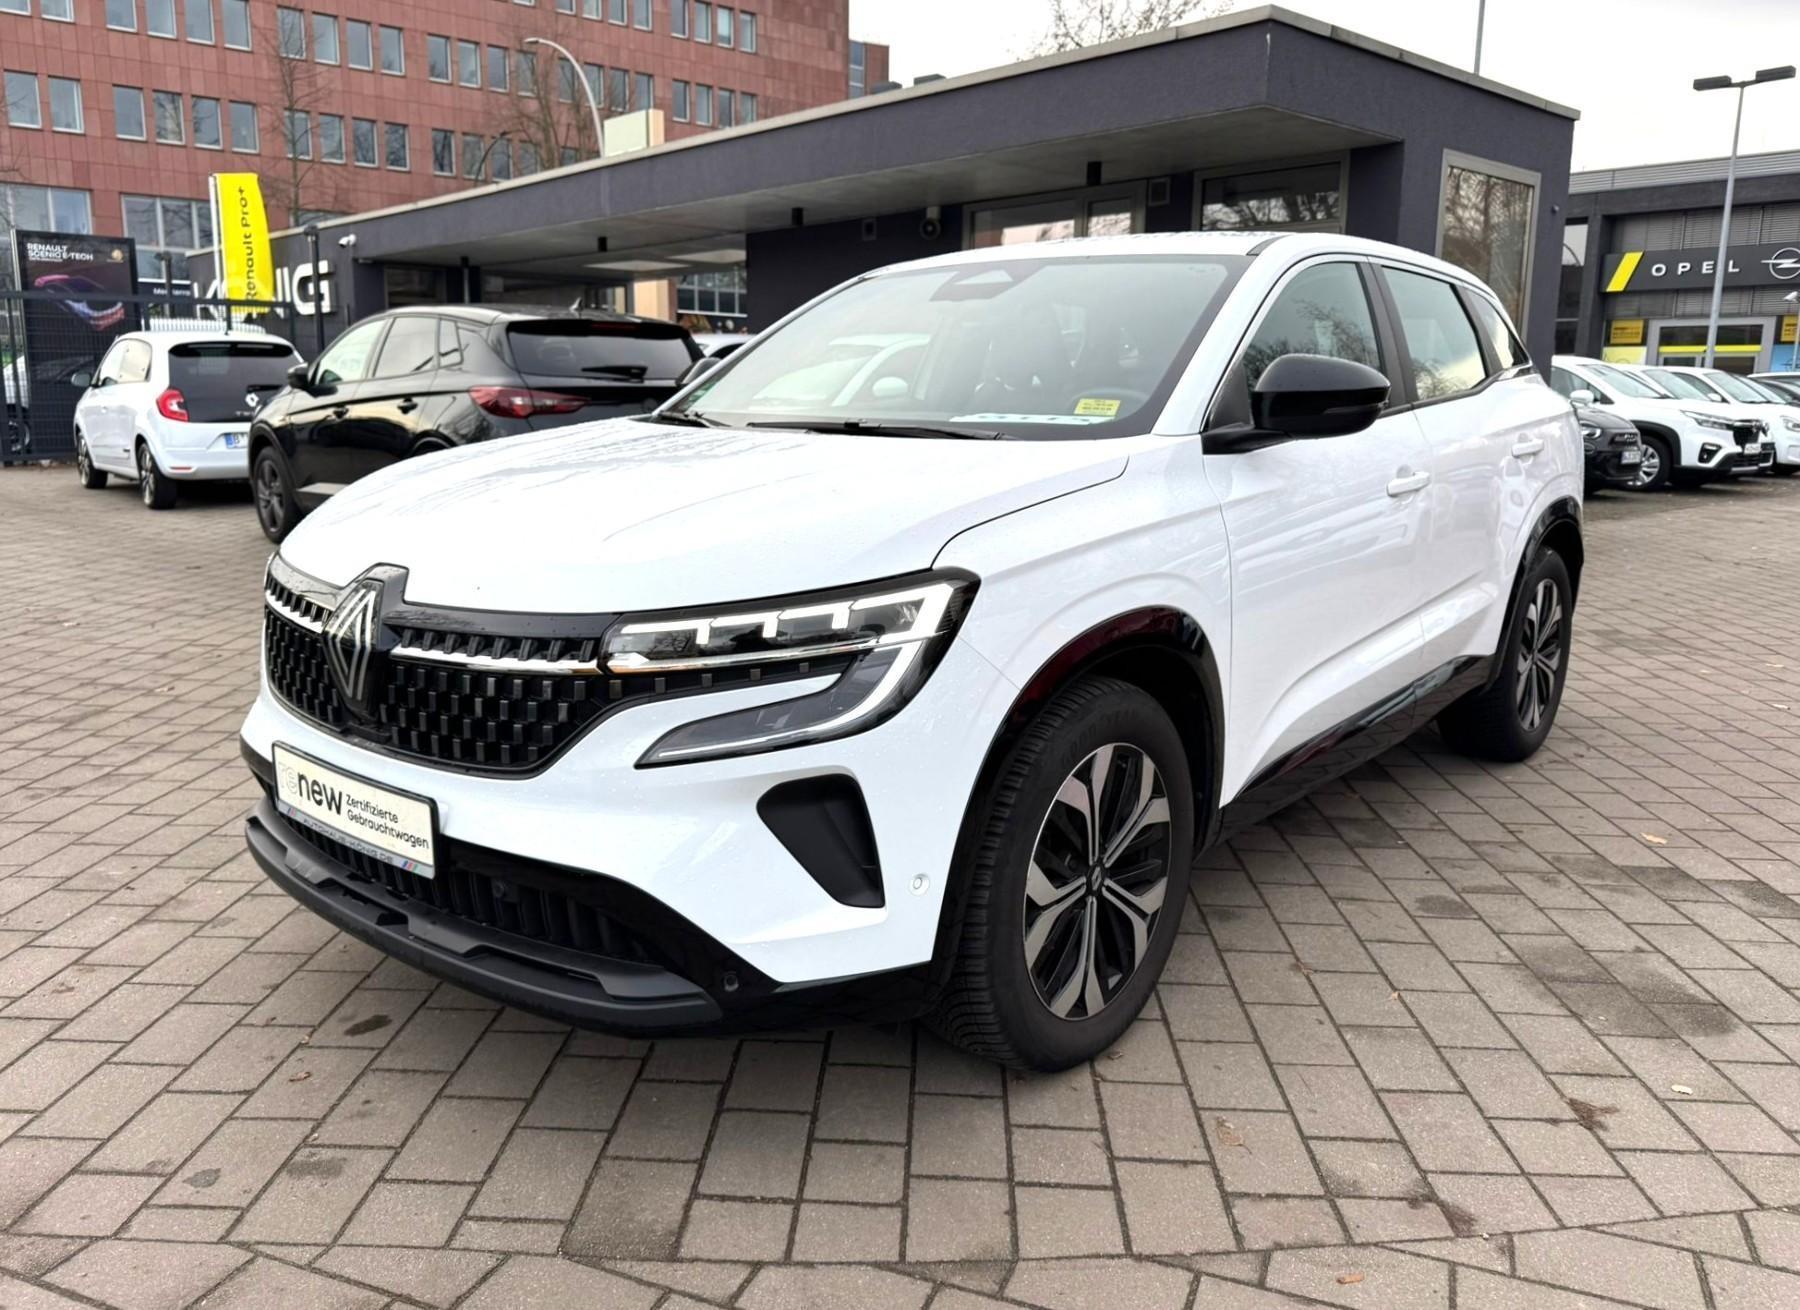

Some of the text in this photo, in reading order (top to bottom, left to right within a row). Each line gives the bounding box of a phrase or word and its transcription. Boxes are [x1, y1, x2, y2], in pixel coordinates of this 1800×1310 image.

[238, 186, 251, 227] Pro+
[26, 242, 68, 252] RENAULT
[1651, 260, 1740, 277] OPEL
[346, 794, 399, 824] Zertifizierte
[347, 810, 430, 849] Gebrauchtwagen
